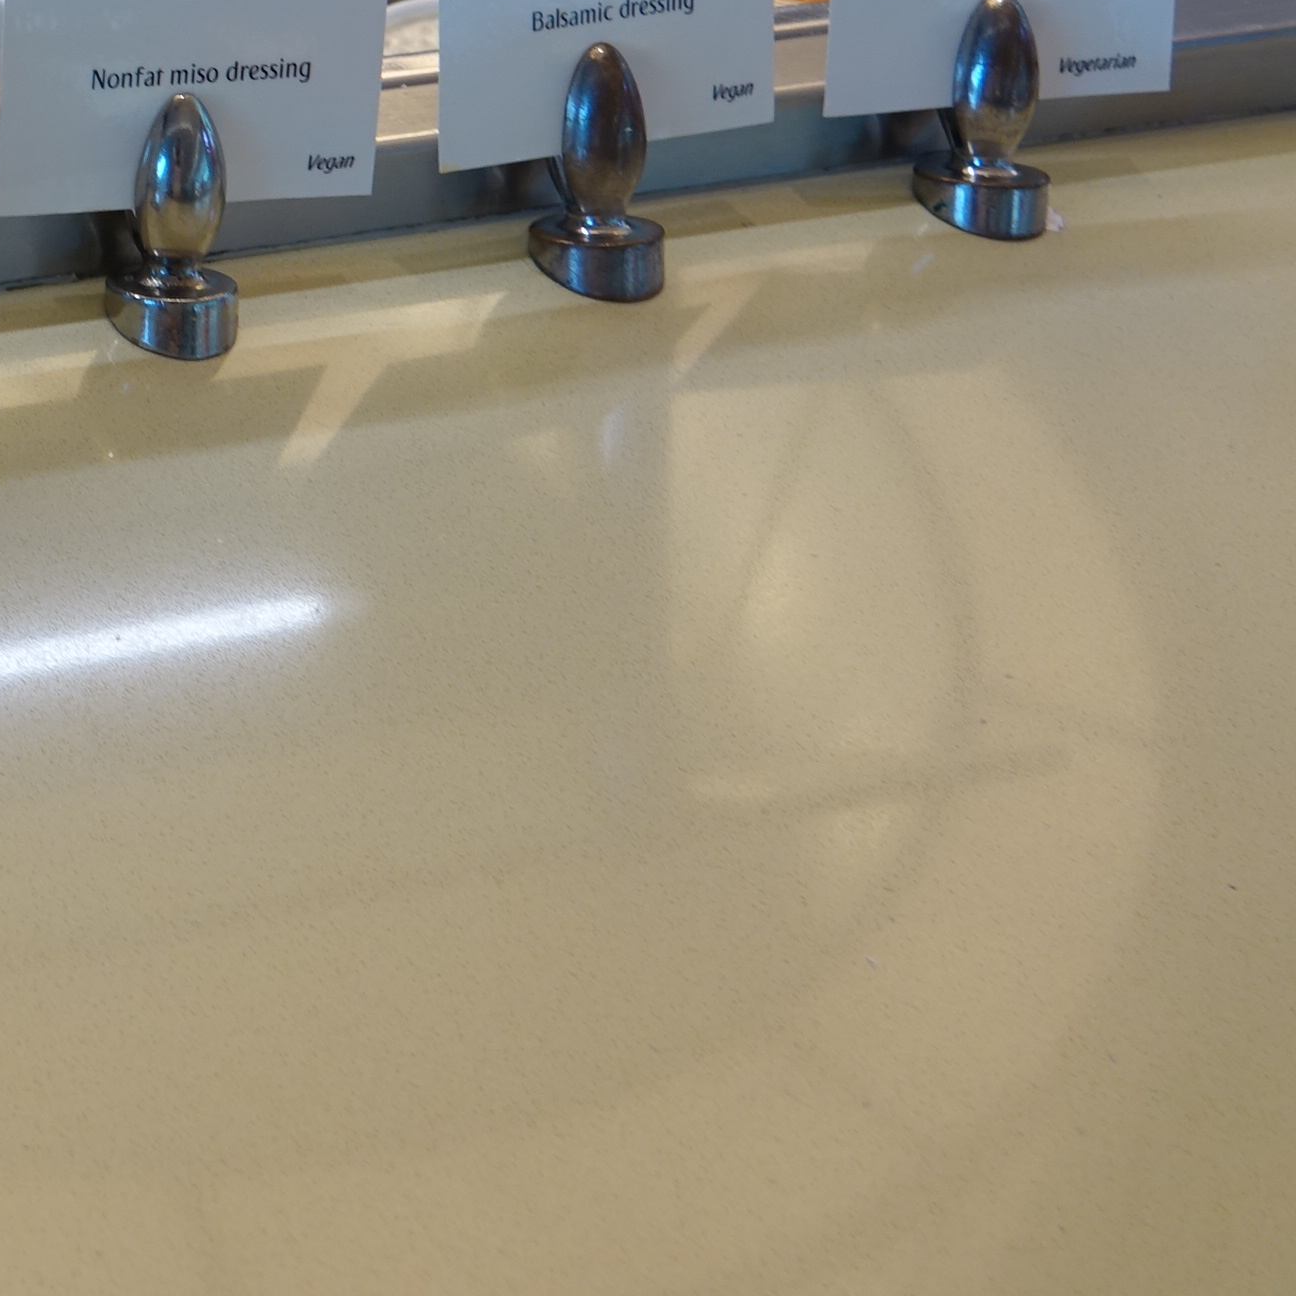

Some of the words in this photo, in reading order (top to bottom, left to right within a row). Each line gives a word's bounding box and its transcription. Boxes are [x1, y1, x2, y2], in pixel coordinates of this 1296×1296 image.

[531, 3, 615, 33] Balsamic
[91, 65, 165, 91] Nonfat
[169, 65, 220, 86] miso
[225, 57, 312, 84] dressing
[1058, 52, 1137, 77] Vegetarian
[712, 82, 755, 103] Vegan
[307, 152, 356, 175] Vegan
